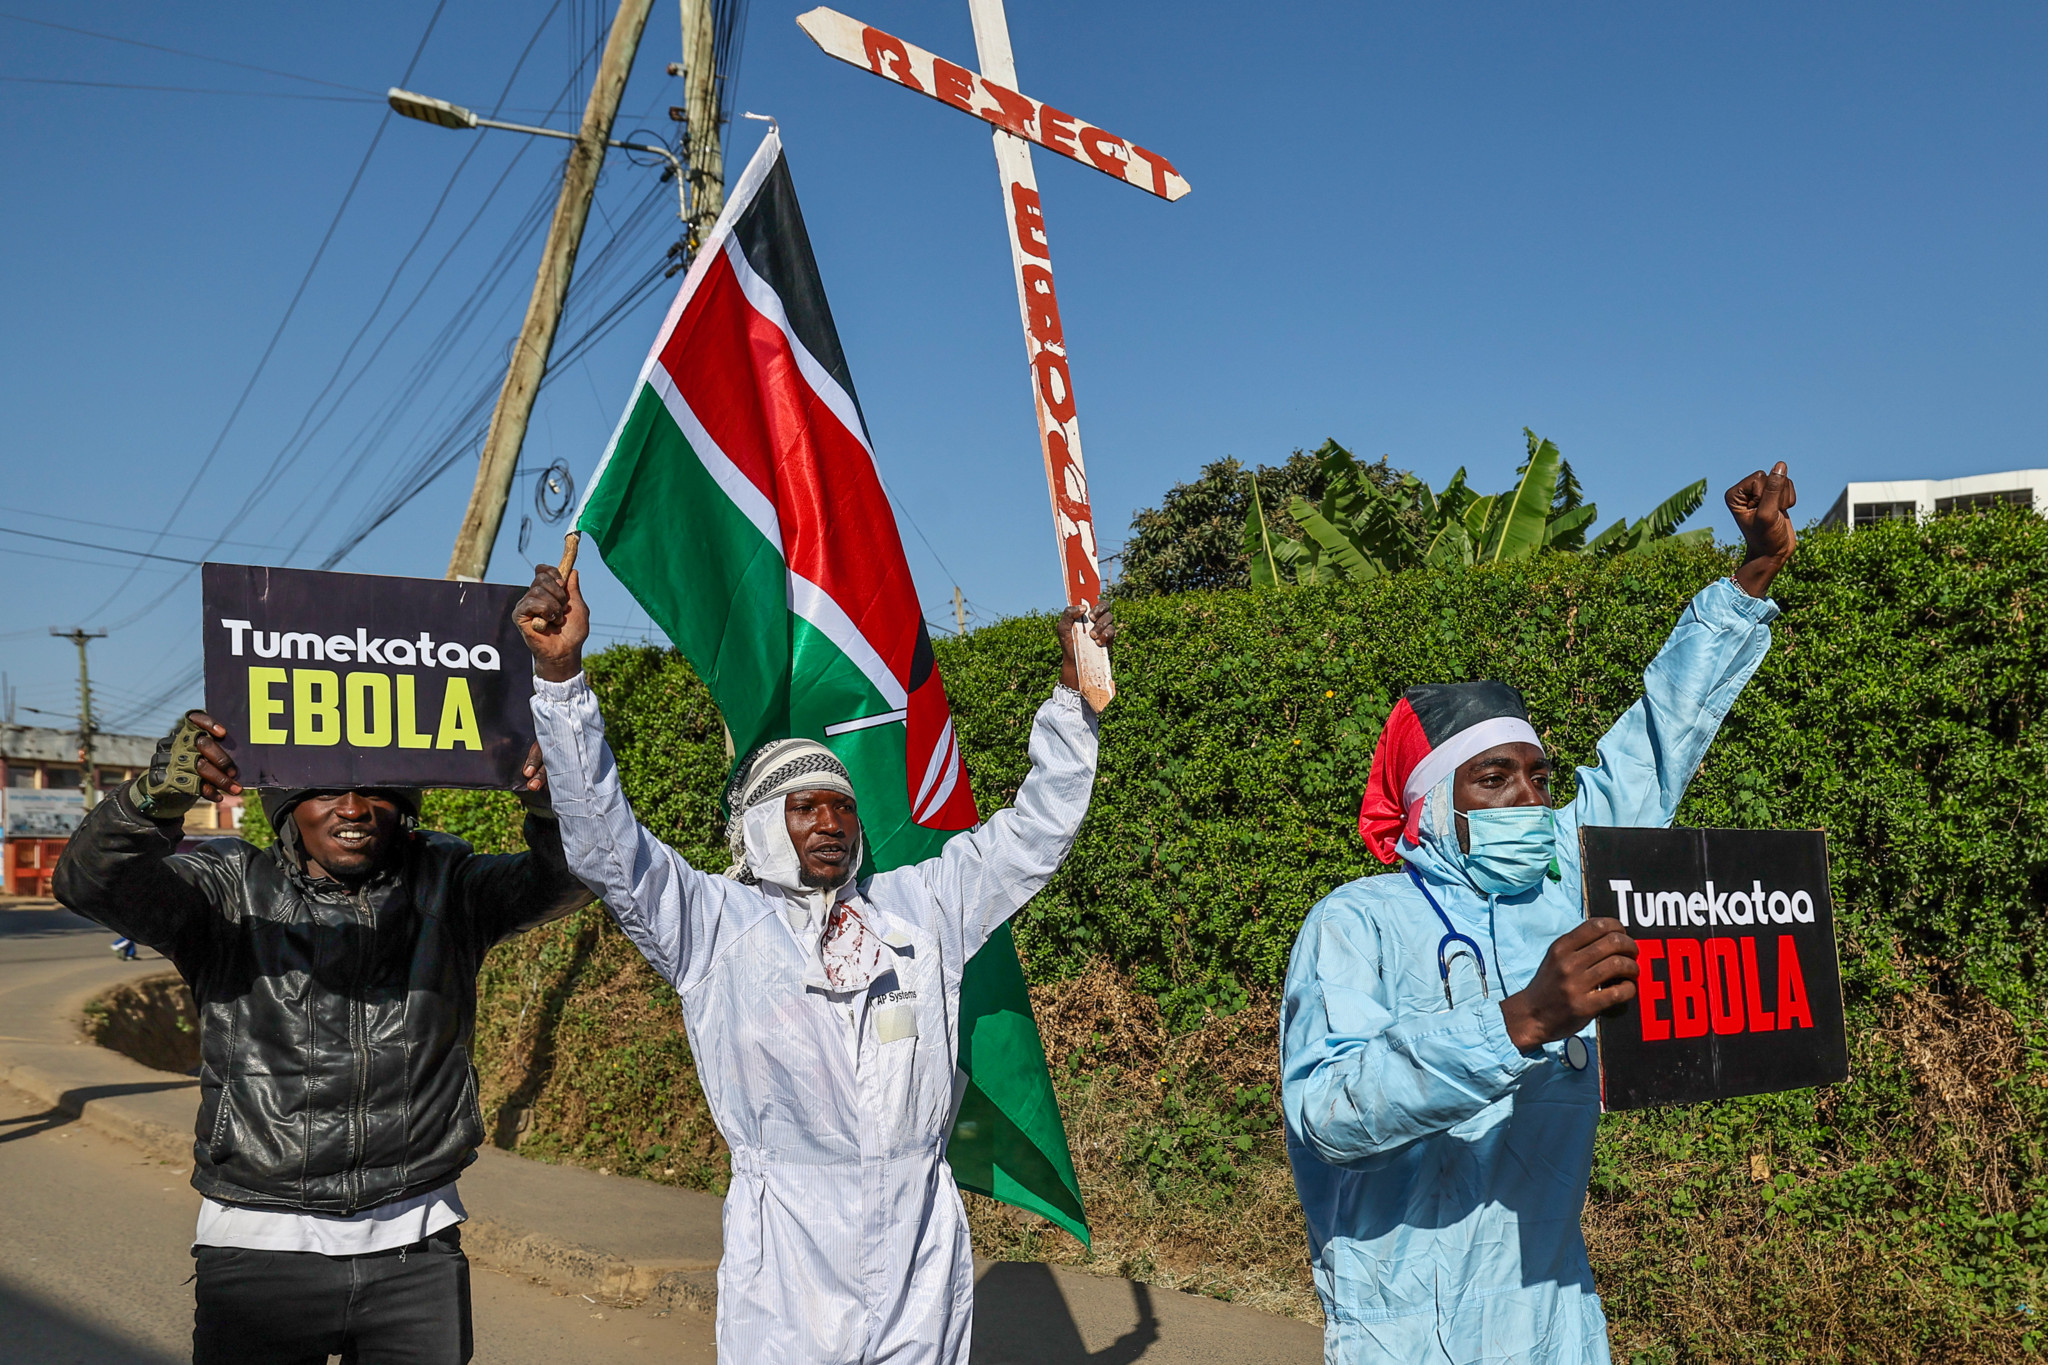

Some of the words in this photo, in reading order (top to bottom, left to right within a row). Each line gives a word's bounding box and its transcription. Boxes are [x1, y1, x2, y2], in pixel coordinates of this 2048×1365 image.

[862, 27, 1180, 198] REJECT
[221, 618, 501, 671] Tumekataa
[248, 666, 484, 751] EBOLA
[1609, 879, 1815, 927] Tumekataa
[889, 990, 917, 1003] Systems
[1634, 935, 1815, 1042] EBOLA
